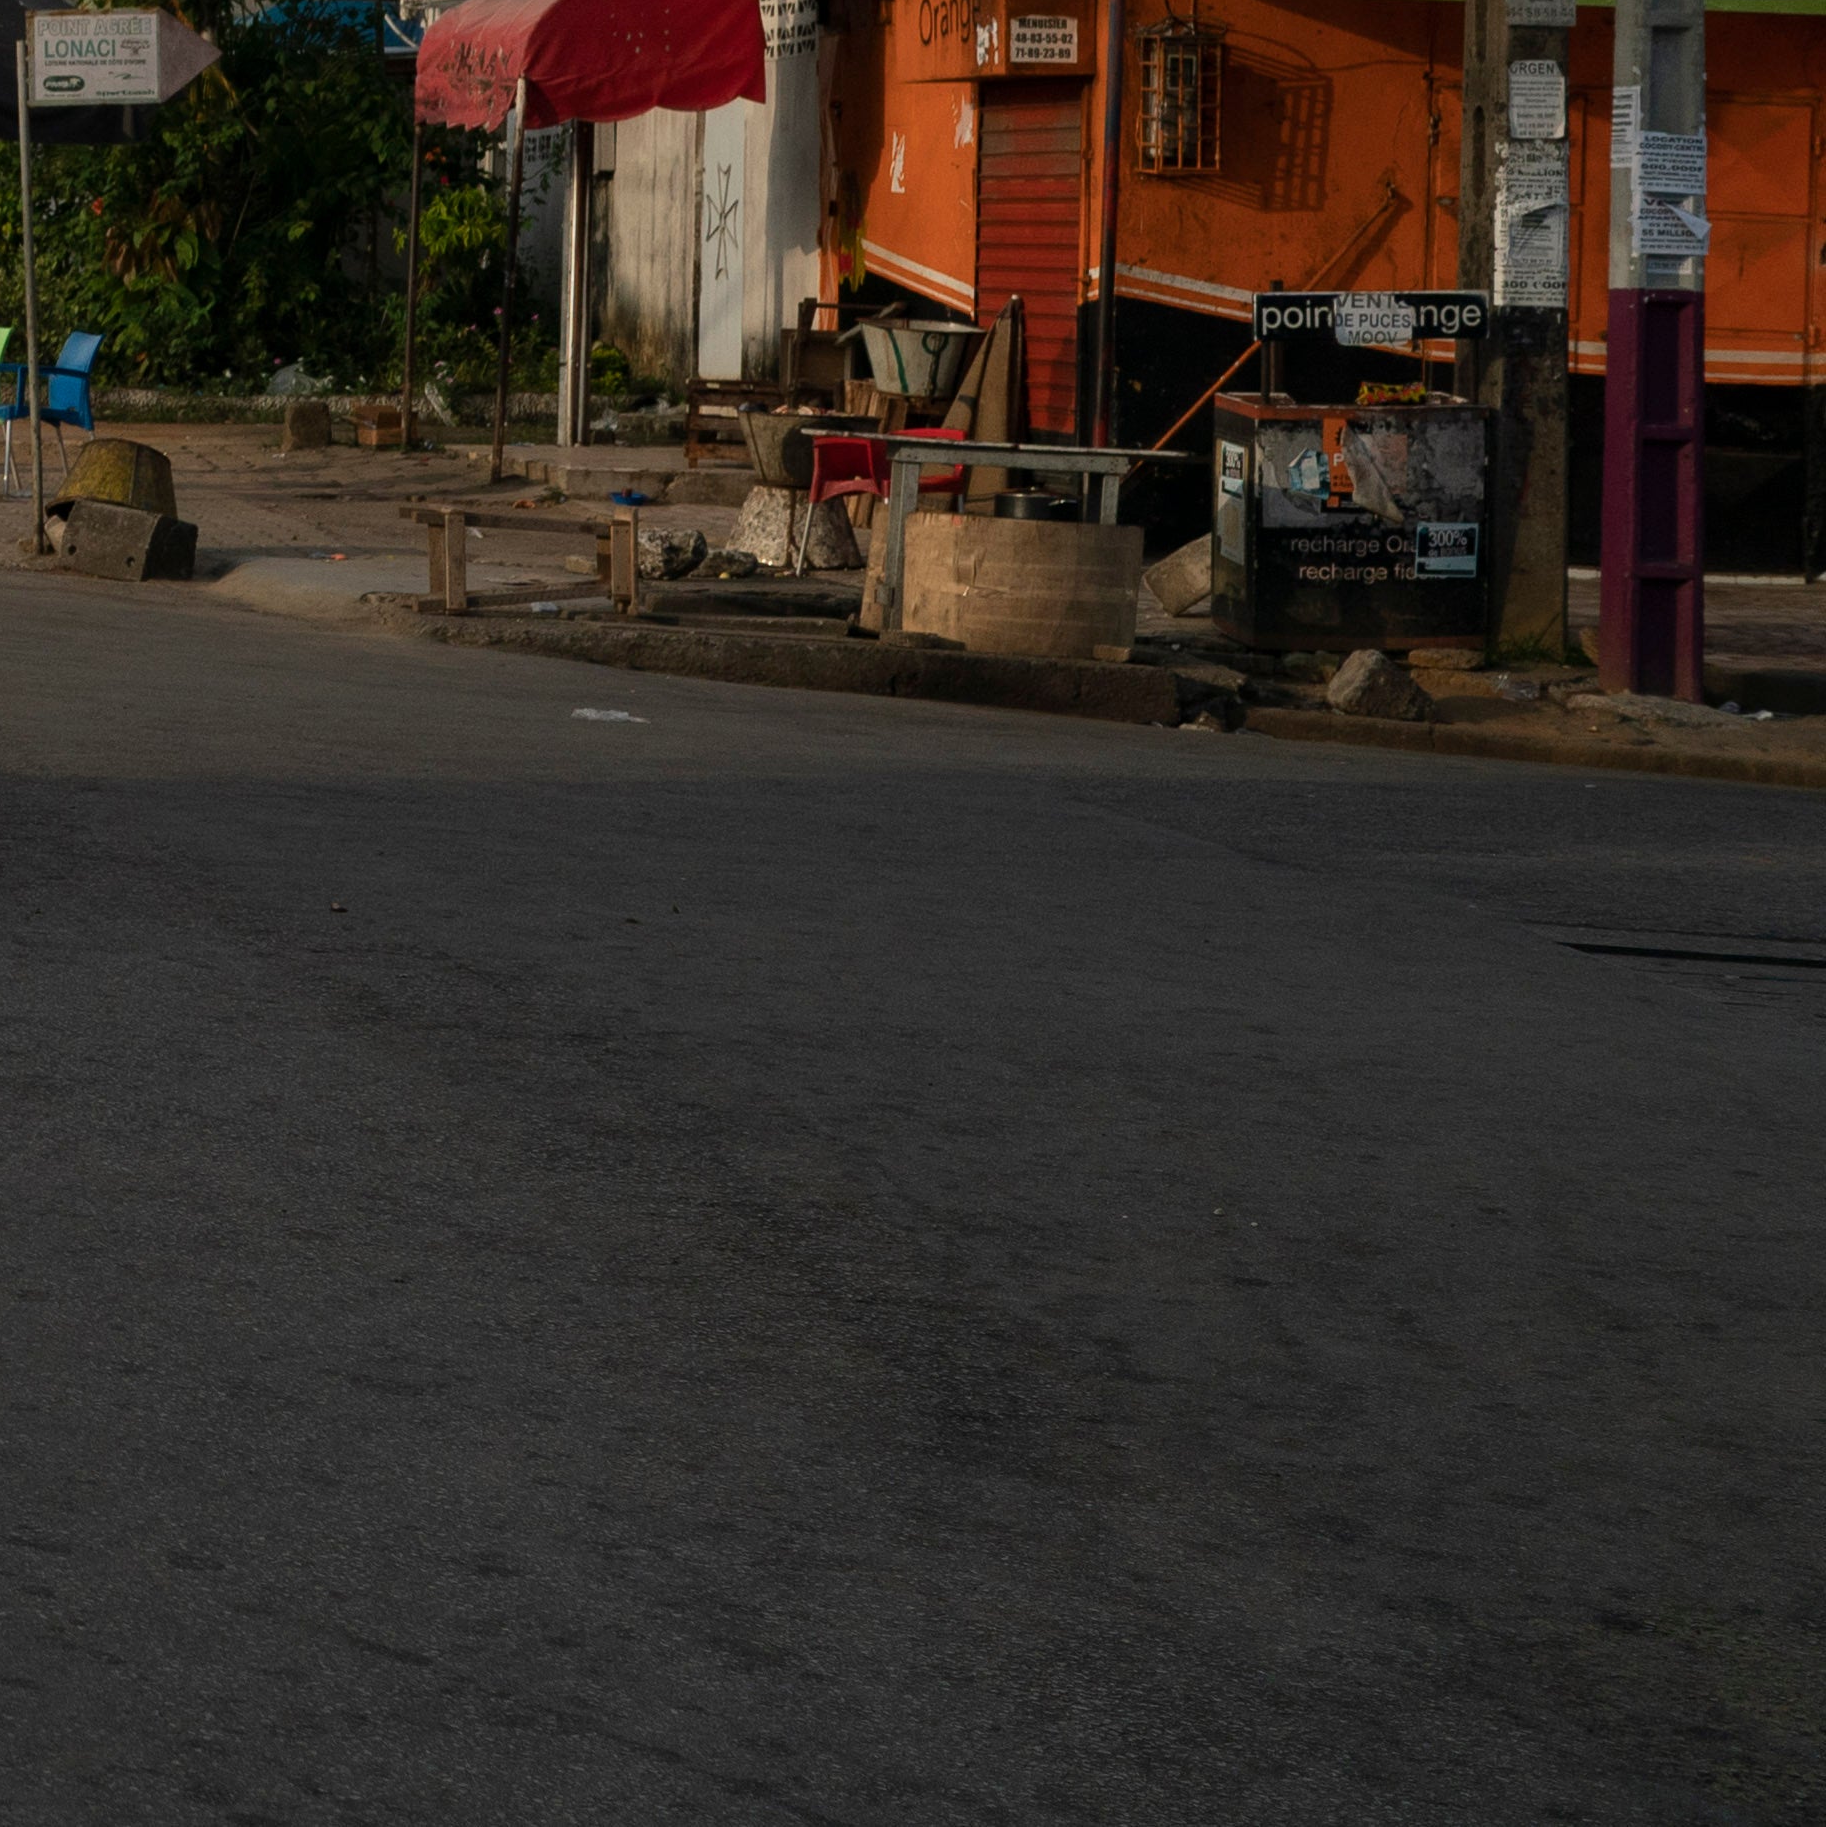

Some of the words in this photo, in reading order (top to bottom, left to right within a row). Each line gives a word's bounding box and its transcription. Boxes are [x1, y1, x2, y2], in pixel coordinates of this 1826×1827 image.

[36, 19, 89, 36] POINT
[93, 14, 153, 36] AGRÉE
[1018, 17, 1068, 30] MENUISIER
[44, 39, 116, 58] LONACI
[1510, 63, 1556, 76] URGEN
[1657, 229, 1697, 238] MILLIO
[1262, 300, 1335, 335] poin
[1336, 314, 1354, 328] DE
[1359, 314, 1412, 330] PUCES
[1348, 331, 1399, 346] MOOV
[1290, 535, 1381, 558] recharge
[1428, 530, 1468, 548] 300%
[1299, 562, 1389, 585] recharge
